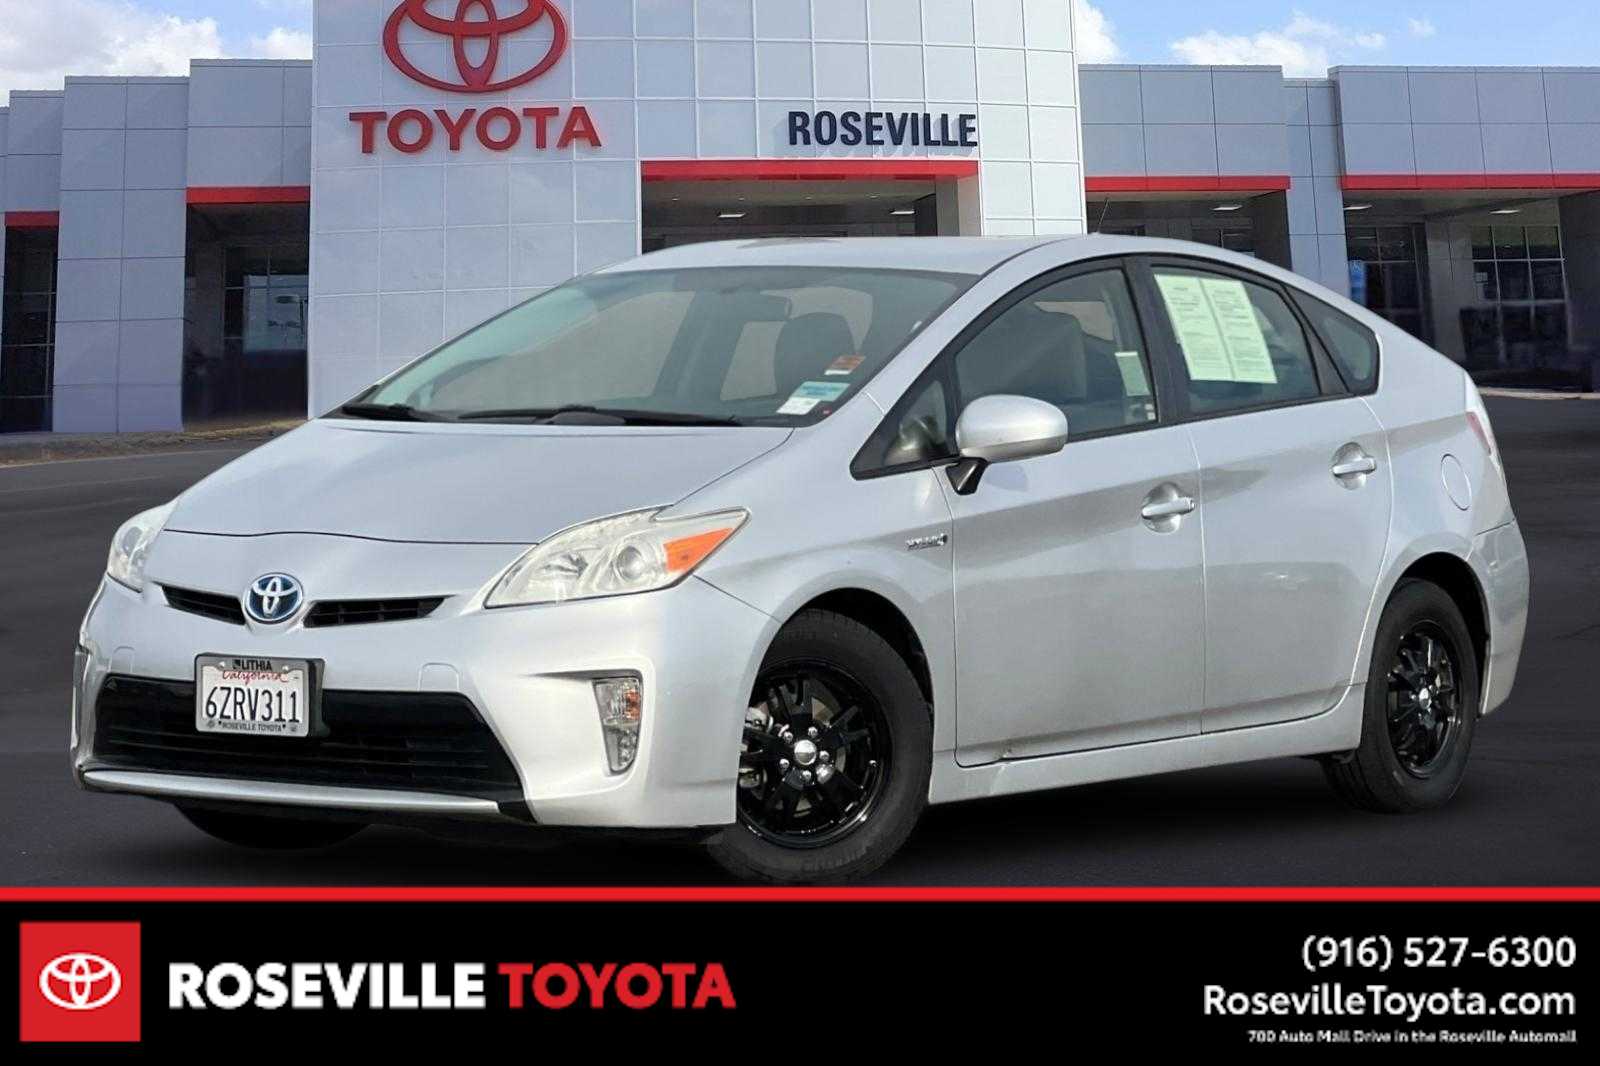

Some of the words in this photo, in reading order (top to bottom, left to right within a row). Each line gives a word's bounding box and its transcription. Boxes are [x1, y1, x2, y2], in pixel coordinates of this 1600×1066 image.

[349, 106, 602, 154] TOYOTA
[788, 111, 978, 147] ROSEVILLE
[241, 659, 273, 671] LITHIA
[205, 686, 300, 723] 6ZRV311
[222, 721, 256, 731] ROSEVILLE
[257, 723, 282, 732] TOYOTA
